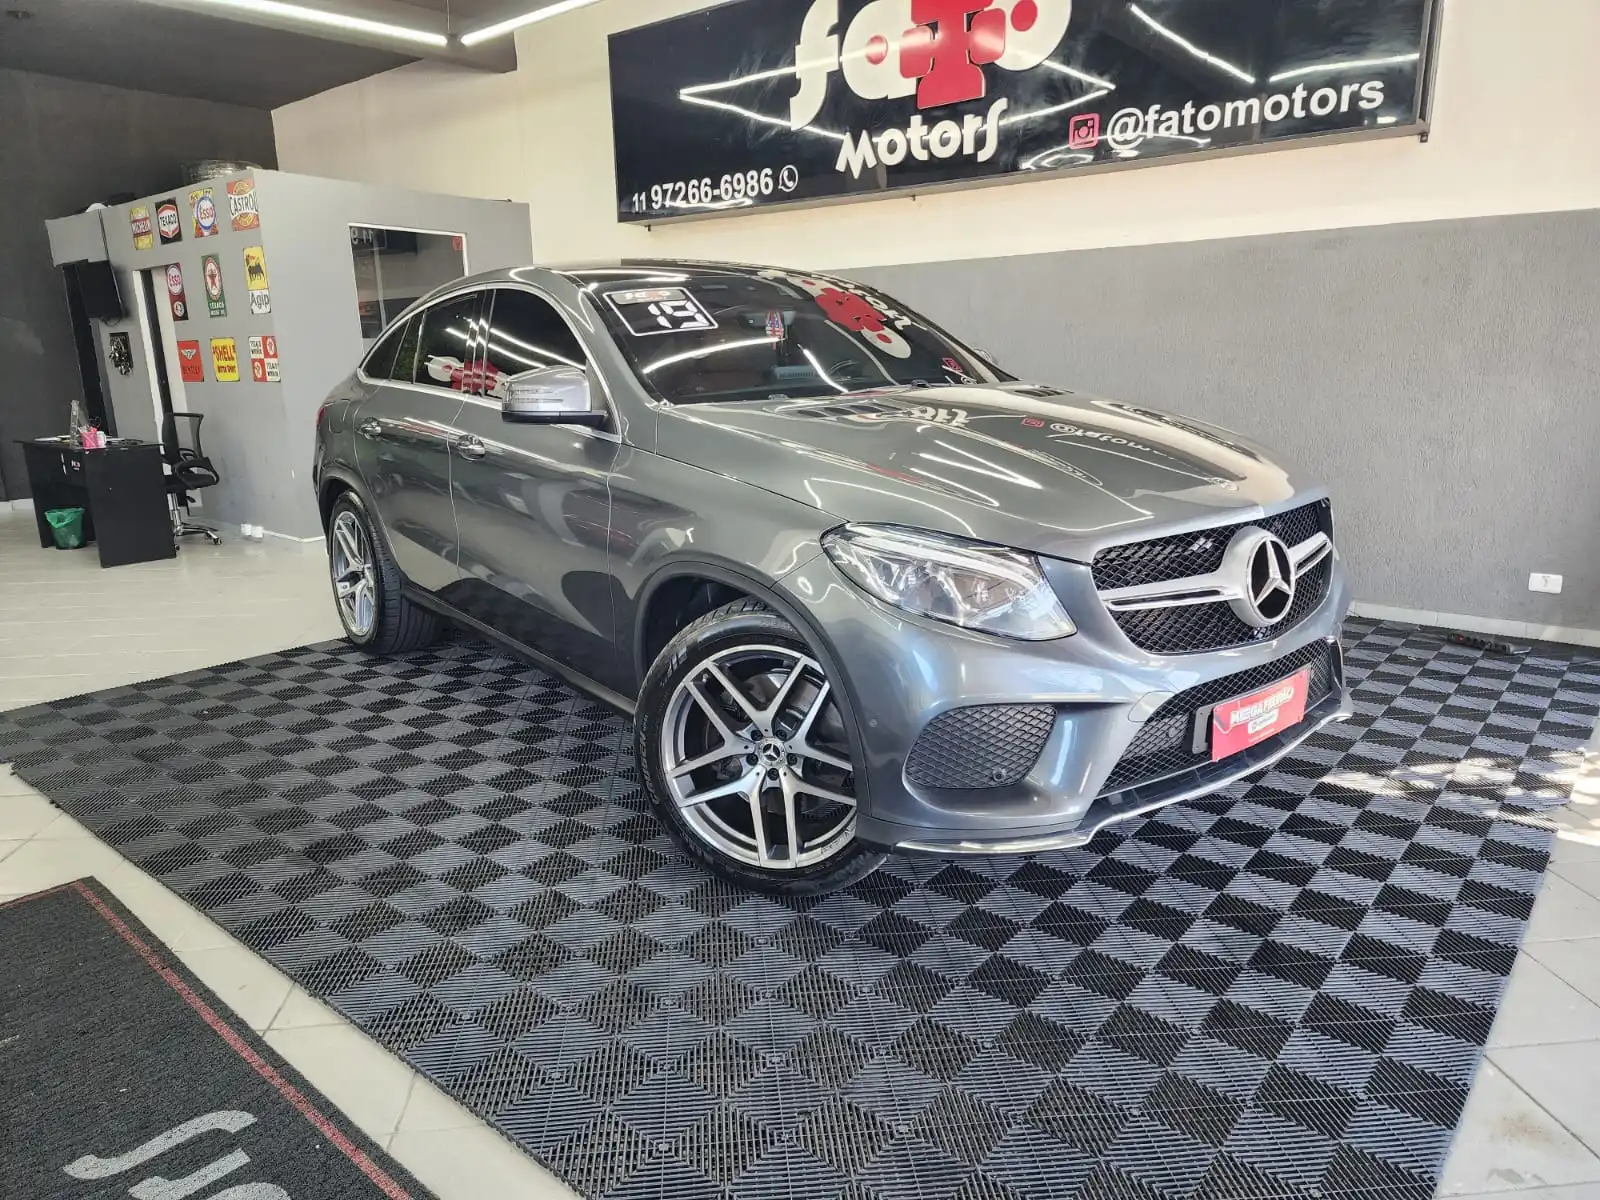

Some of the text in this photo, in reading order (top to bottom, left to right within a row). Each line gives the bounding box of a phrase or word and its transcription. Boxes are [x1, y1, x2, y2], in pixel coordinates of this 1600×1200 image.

[1105, 80, 1385, 149] @fatomotors
[835, 98, 1008, 179] Motors
[229, 192, 259, 216] CASTROL
[632, 168, 774, 213] 11 97266-6986
[159, 213, 177, 226] TEXACO
